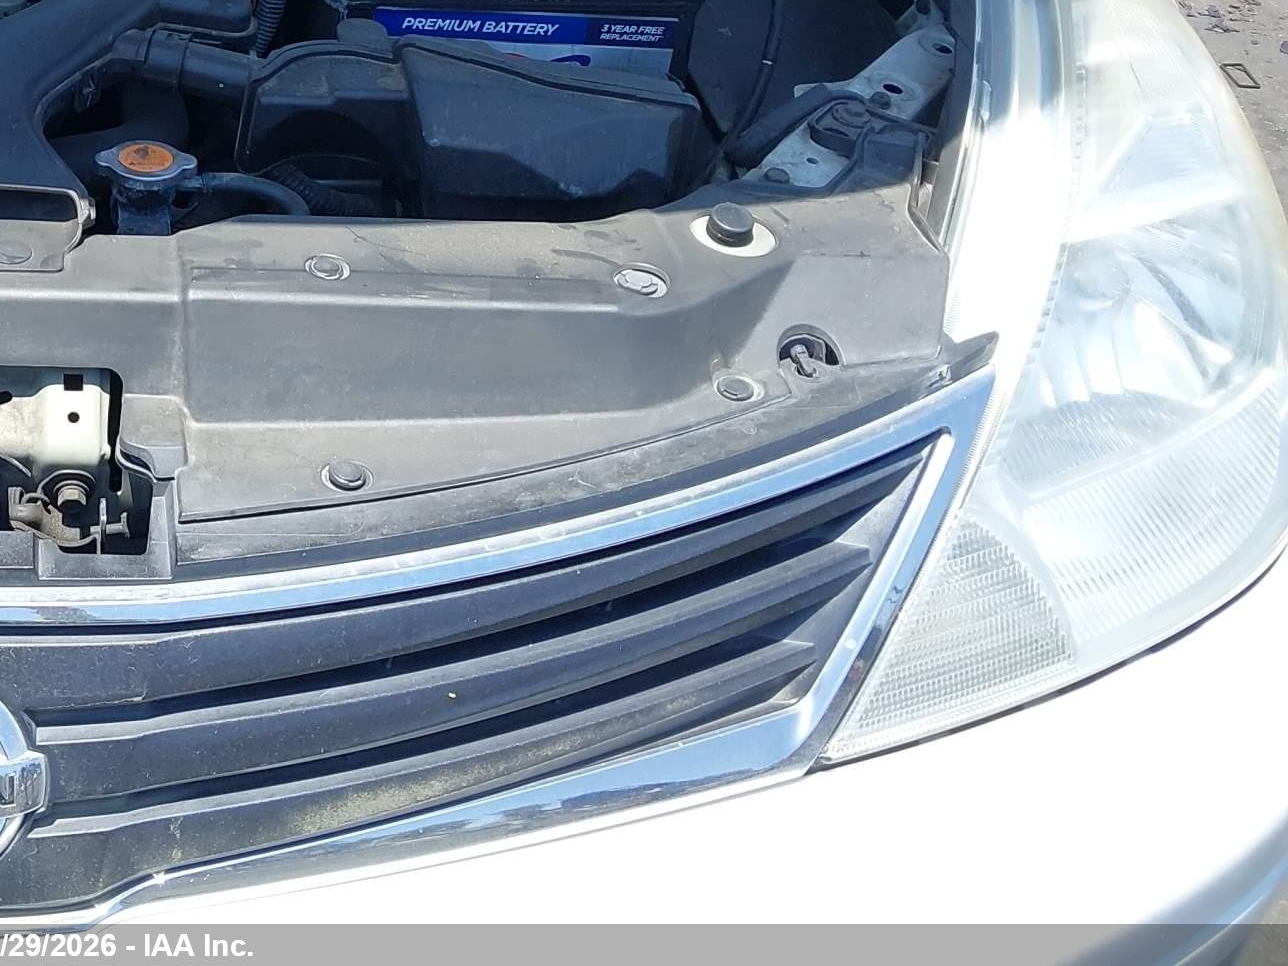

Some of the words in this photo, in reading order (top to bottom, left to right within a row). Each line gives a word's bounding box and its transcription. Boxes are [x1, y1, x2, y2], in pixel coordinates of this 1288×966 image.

[401, 17, 480, 33] PREMIUM
[482, 20, 559, 36] BATTERY
[600, 24, 610, 33] 3
[609, 24, 640, 34] YEAR
[640, 26, 666, 35] FREE
